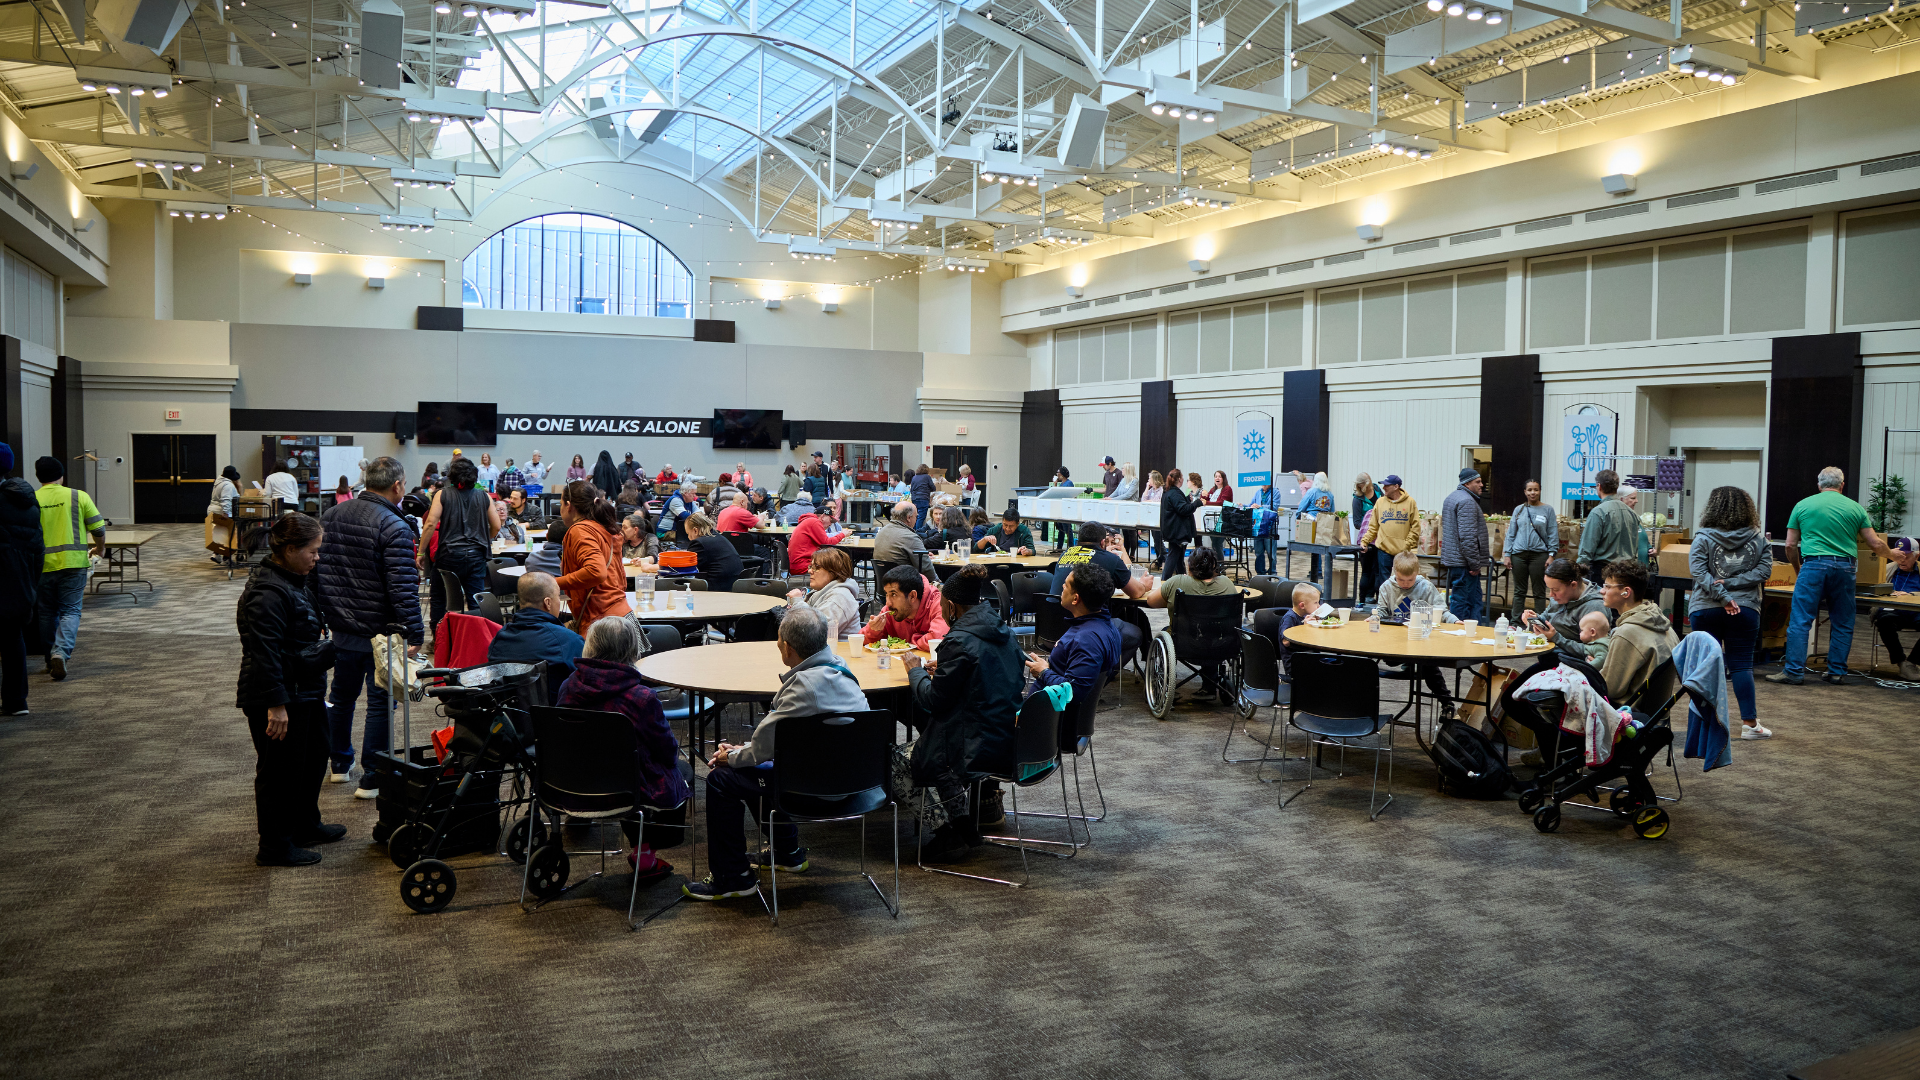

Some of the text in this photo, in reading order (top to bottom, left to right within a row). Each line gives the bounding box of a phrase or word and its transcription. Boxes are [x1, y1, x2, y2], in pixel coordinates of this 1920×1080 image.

[168, 410, 180, 419] EXIT
[503, 417, 701, 434] NO ONE WALKS ALONE
[957, 426, 966, 434] EXIT
[1243, 475, 1266, 483] FROZEN
